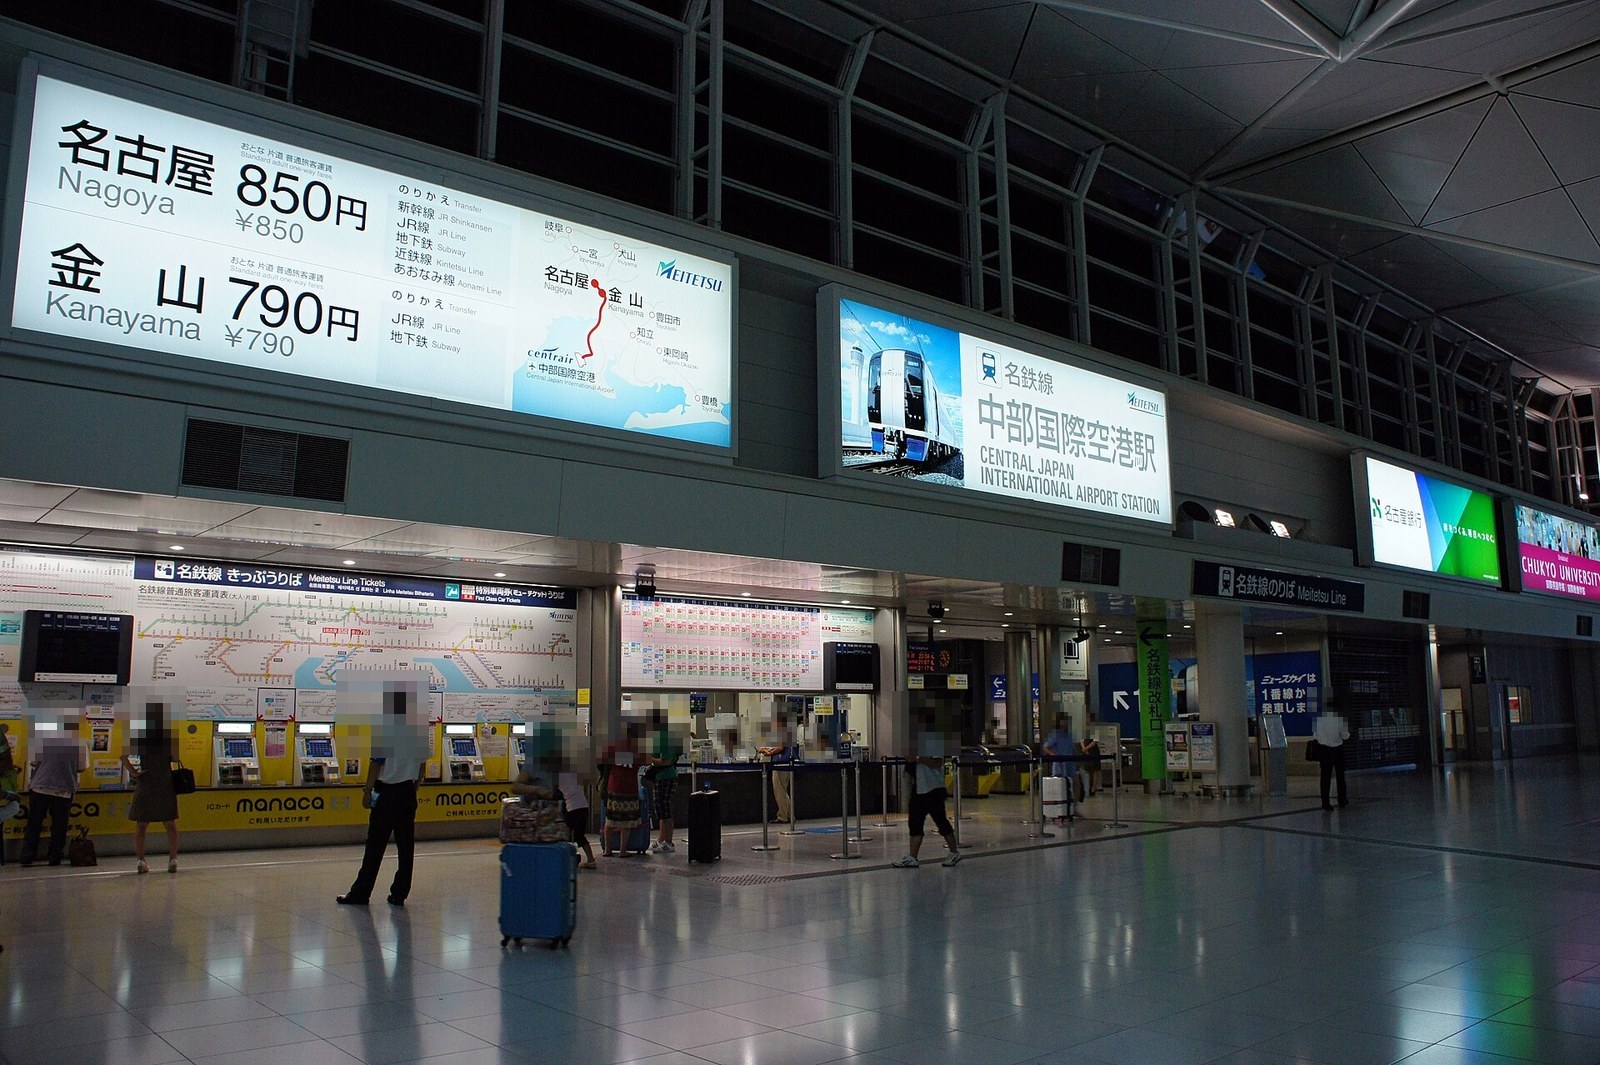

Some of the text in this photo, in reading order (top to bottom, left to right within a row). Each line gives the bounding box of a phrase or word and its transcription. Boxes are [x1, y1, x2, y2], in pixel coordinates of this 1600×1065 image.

[58, 119, 215, 196] 名古屋
[240, 142, 265, 155] おとな
[267, 149, 283, 160] 片道
[240, 151, 271, 164] Standard
[272, 159, 288, 169] adult
[58, 166, 175, 216] Nagoya
[236, 164, 367, 231] 850円
[398, 184, 483, 214] のりかえ Transfer
[236, 209, 303, 243] ¥850
[397, 200, 494, 233] 新幹線 JR Shinkansen
[544, 220, 564, 233] 岐阜
[397, 217, 467, 242] JR線 JR Line
[396, 231, 467, 258] 地下鉄 Subway
[579, 248, 598, 260] 一宮
[617, 248, 636, 261] 犬山
[230, 256, 255, 267] おとな
[257, 261, 274, 272] 片道
[230, 265, 261, 277] Standard
[394, 246, 485, 277] 近鉄線 Kintetsu Line
[394, 263, 503, 296] あおなみ線 Aonami Line
[544, 265, 589, 290] 名古屋
[656, 259, 722, 292] MEITETSU
[544, 281, 573, 296] Nagoya
[608, 286, 643, 309] 金山
[46, 290, 201, 340] Kanayama
[229, 276, 359, 341] 790円
[391, 290, 478, 316] のりかえ Transfer
[607, 303, 644, 318] Kanayama
[391, 312, 462, 334] JR線 JR Line
[656, 311, 681, 326] 豊田市
[225, 324, 294, 357] ¥790
[390, 330, 461, 354] 地下鉄 Subway
[636, 327, 654, 339] 知立
[527, 347, 574, 365] centrair
[526, 371, 615, 395] Central Japan International Airport
[538, 363, 596, 383] 中部国際空港
[1004, 361, 1054, 395] 名鉄線
[1127, 391, 1159, 413] MEITETSU
[978, 393, 1156, 473] 中部国際空港駅
[980, 445, 1074, 481] CENTRAL JAPAN
[981, 467, 1160, 515] INTERNATIONAL AIRPORT STATION
[1385, 504, 1422, 528] 名古屋銀行
[177, 564, 386, 588] 名鉄線 きっぷうりば Meitetsu Line Tickets
[1521, 556, 1557, 579] CHUKYO
[1236, 573, 1347, 605] 名鉄線のりば Meitetsu Line
[1146, 649, 1163, 731] 名鉄線改札口
[1262, 687, 1317, 701] 1番線か
[1262, 702, 1317, 714] 発車しま
[236, 796, 324, 812] manaca
